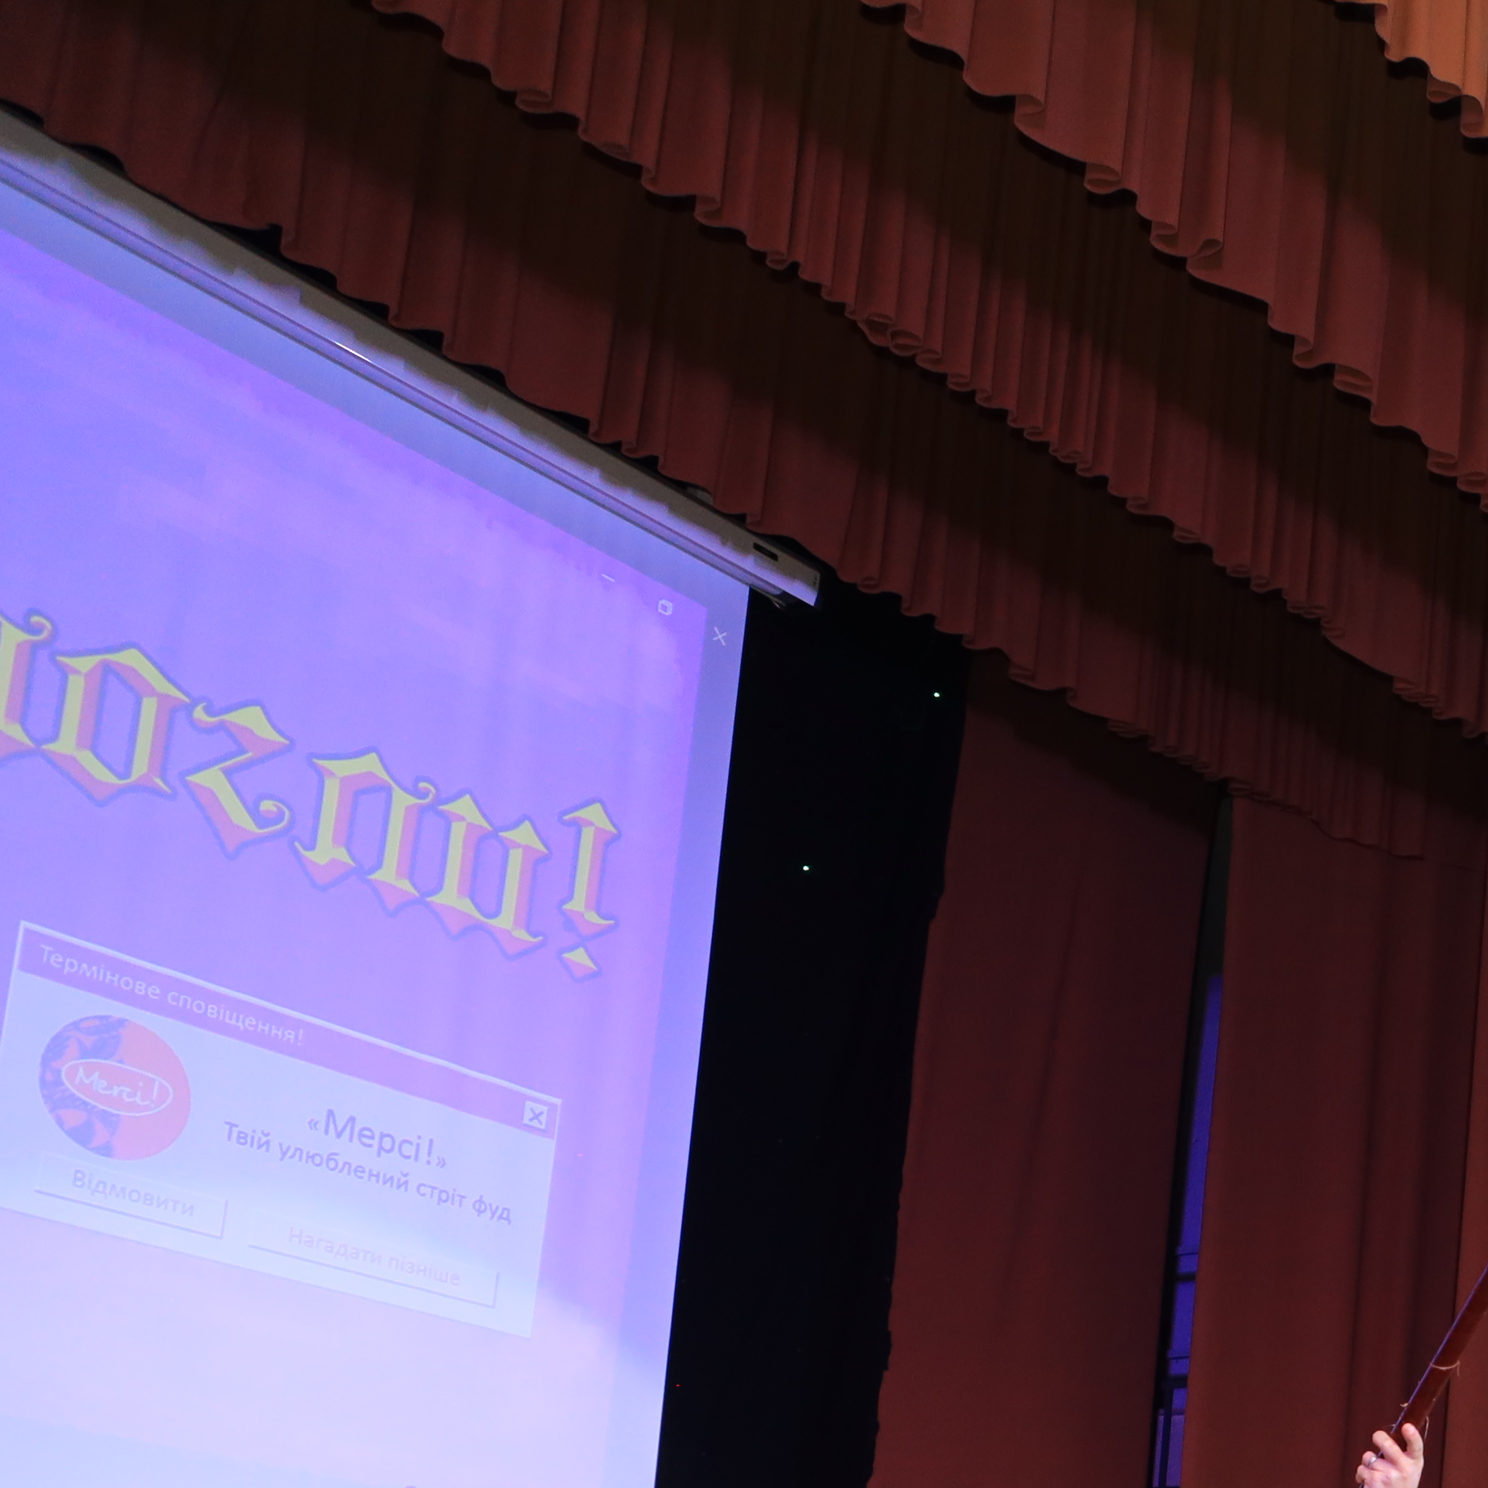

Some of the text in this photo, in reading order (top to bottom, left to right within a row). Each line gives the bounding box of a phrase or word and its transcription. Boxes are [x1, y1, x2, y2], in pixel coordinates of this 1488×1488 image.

[40, 944, 304, 1047] Термінове сповіщення!
[306, 1108, 447, 1169] «Мерсі!»
[72, 1169, 195, 1217] Відмовити
[223, 1120, 512, 1225] Твій улюблений стріт фуд
[288, 1226, 461, 1287] Нагадати пізніше
